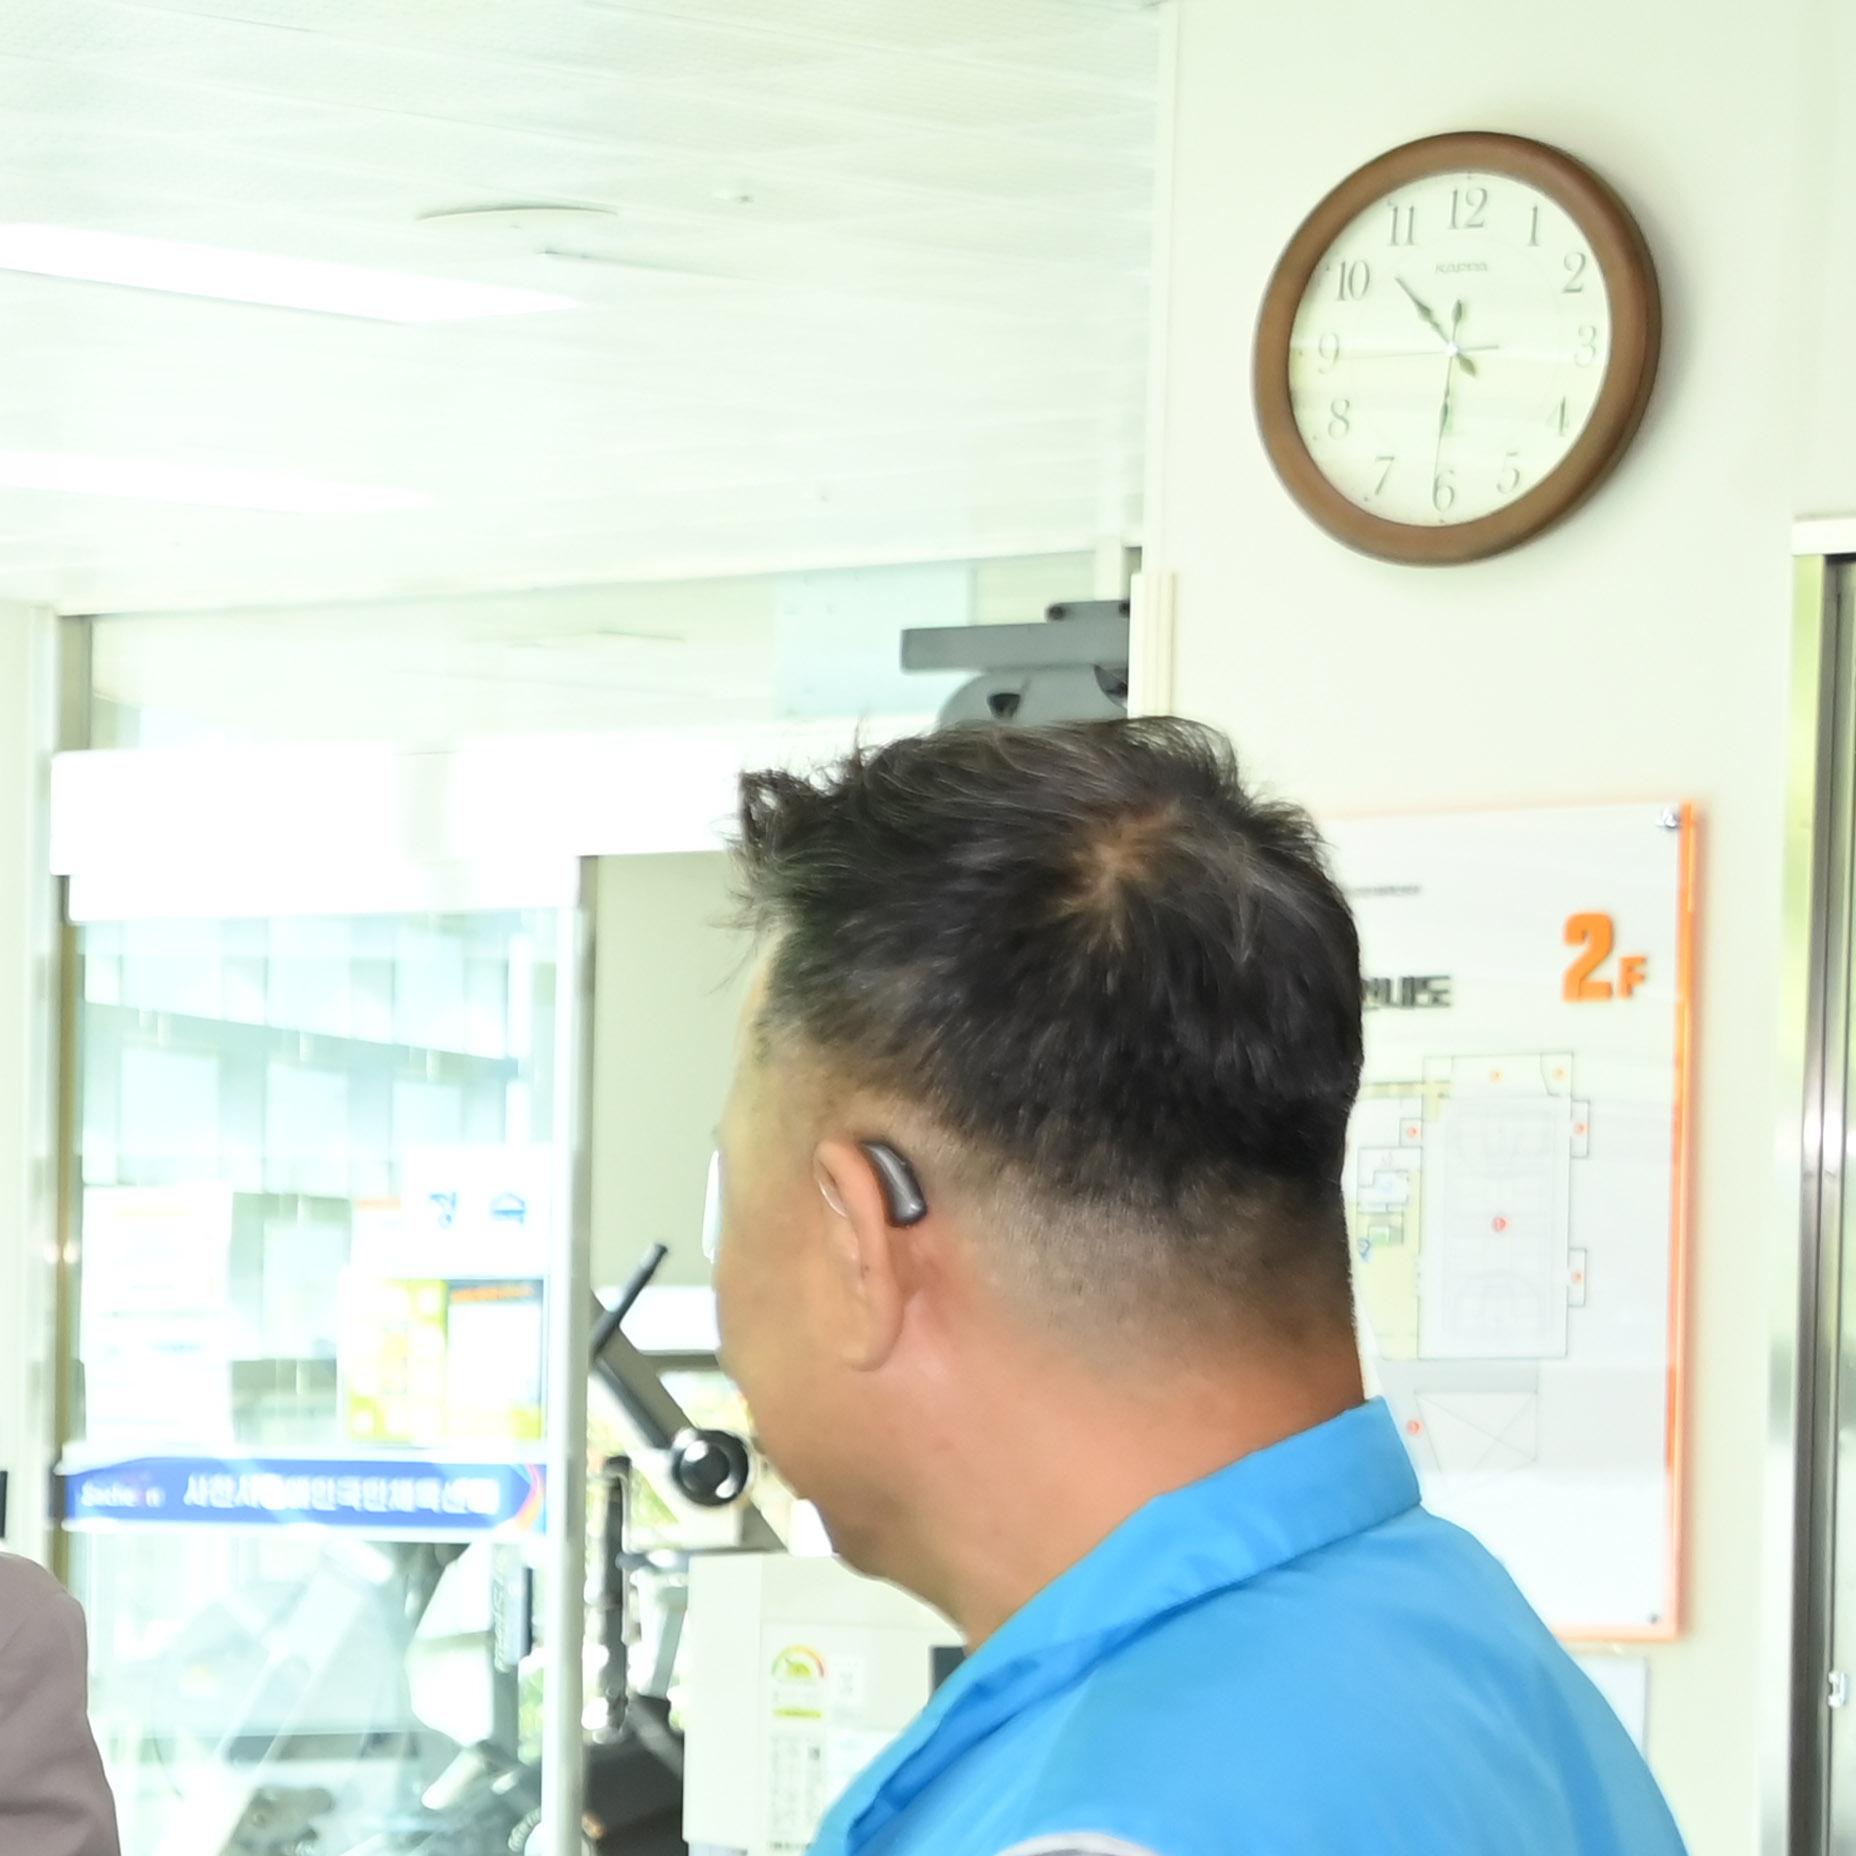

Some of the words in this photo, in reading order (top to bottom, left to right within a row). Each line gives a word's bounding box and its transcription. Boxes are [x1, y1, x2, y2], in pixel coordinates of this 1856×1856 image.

[1389, 204, 1416, 246] 11
[1448, 187, 1488, 229] 12
[1527, 205, 1541, 246] 1
[1336, 260, 1370, 300] 10
[1562, 252, 1586, 294] 2
[1318, 333, 1341, 374] 9
[1574, 325, 1596, 367] 3
[1328, 399, 1350, 440] 8
[1547, 396, 1571, 437] 4
[1374, 456, 1395, 495] 7
[1433, 469, 1455, 513] 6
[1496, 452, 1520, 494] 5
[1562, 911, 1647, 1003] 2F
